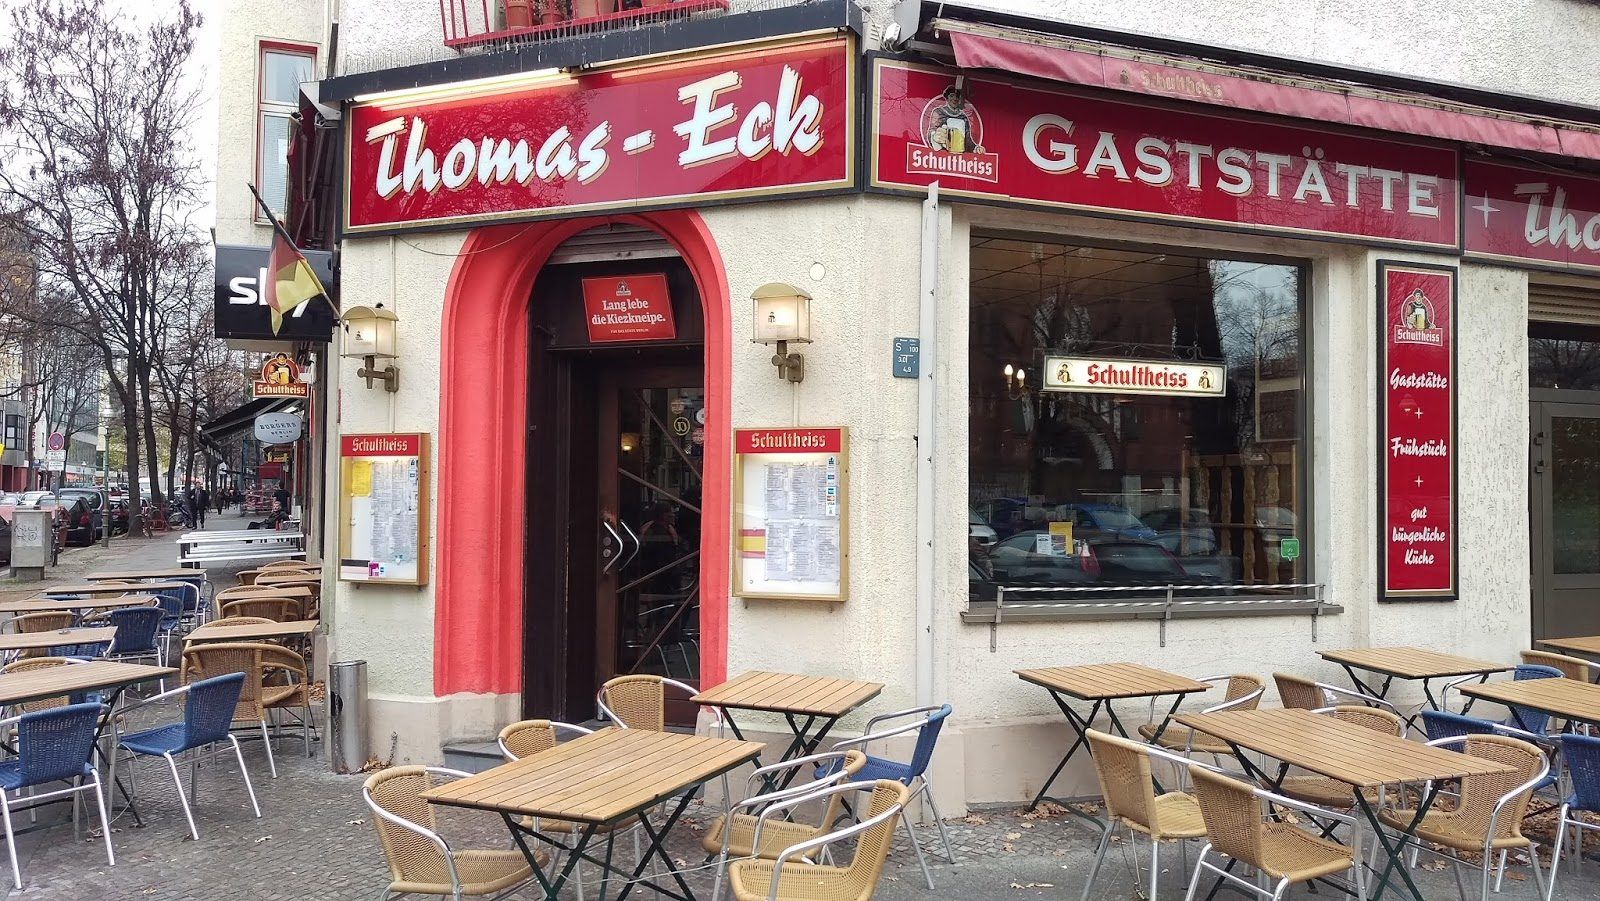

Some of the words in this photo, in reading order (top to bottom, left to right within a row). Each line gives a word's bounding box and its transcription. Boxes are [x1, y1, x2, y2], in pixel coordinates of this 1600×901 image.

[365, 116, 611, 199] Thomas
[673, 64, 823, 170] Eck
[912, 149, 993, 176] Schultheiss
[1022, 113, 1440, 221] GASTSTÄTTE
[602, 300, 627, 312] Lang
[627, 298, 649, 310] lebe
[591, 314, 607, 325] die
[607, 312, 666, 325] Kiezkneipe.
[1397, 329, 1440, 342] Schultheiss
[895, 342, 902, 352] S
[1087, 363, 1188, 388] Schultheiss
[1390, 368, 1447, 390] Gaststätte
[257, 384, 306, 395] Schultheiss
[352, 437, 408, 452] Schultheiss
[751, 432, 826, 449] Schultheiss
[1391, 437, 1447, 458] Frühstück
[1410, 506, 1428, 522] gut
[1392, 527, 1446, 545] bürgerliche
[1404, 548, 1435, 565] Küche
